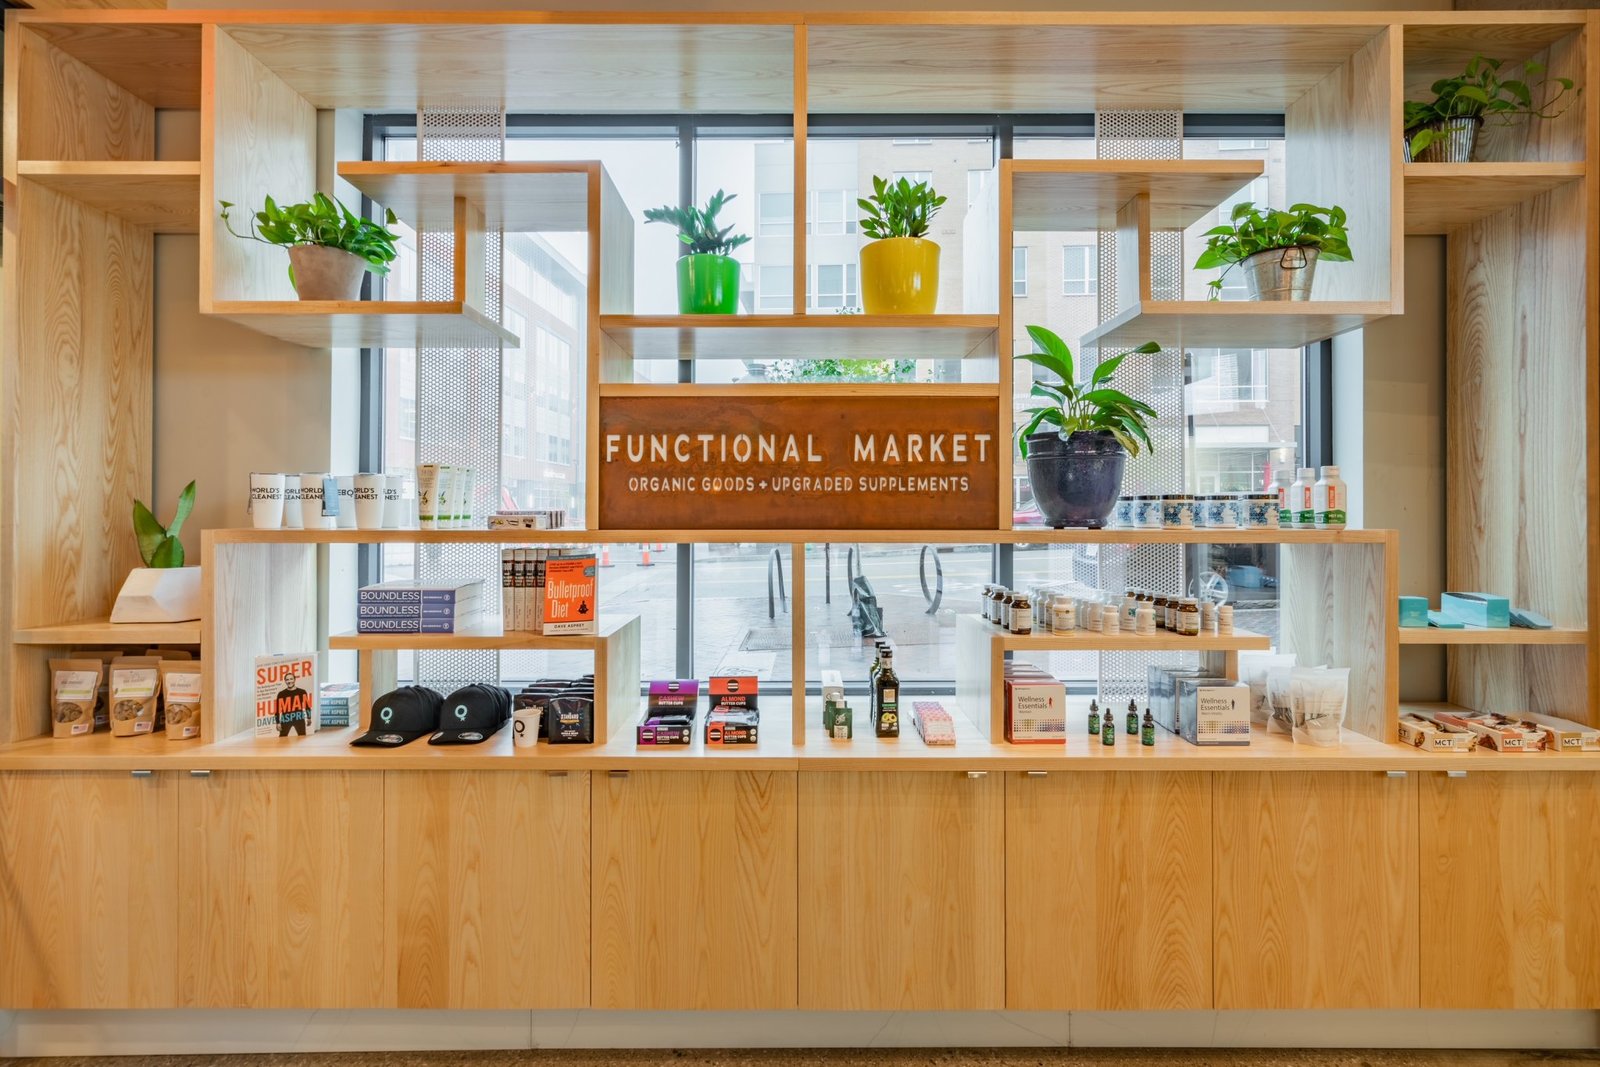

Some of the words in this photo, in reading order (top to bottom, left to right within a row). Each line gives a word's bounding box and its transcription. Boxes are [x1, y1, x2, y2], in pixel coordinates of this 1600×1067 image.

[605, 434, 822, 462] FUNCTIONAL
[854, 434, 991, 462] MARKET
[628, 476, 695, 491] ORGANIC
[702, 476, 755, 491] GOODS
[772, 476, 852, 491] UPGRADED
[859, 476, 969, 492] SUPPLEMENTS
[360, 591, 420, 600] BOUNDLESS
[548, 579, 593, 602] Bulletproof
[360, 606, 420, 615] BOUNDLESS
[552, 600, 569, 618] Diet
[360, 620, 419, 629] BOUNDLESS
[256, 660, 312, 685] SUPER
[256, 693, 313, 718] HUMAN
[257, 717, 276, 728] DAVE
[280, 710, 312, 723] ASPREY
[1563, 738, 1581, 746] MCT
